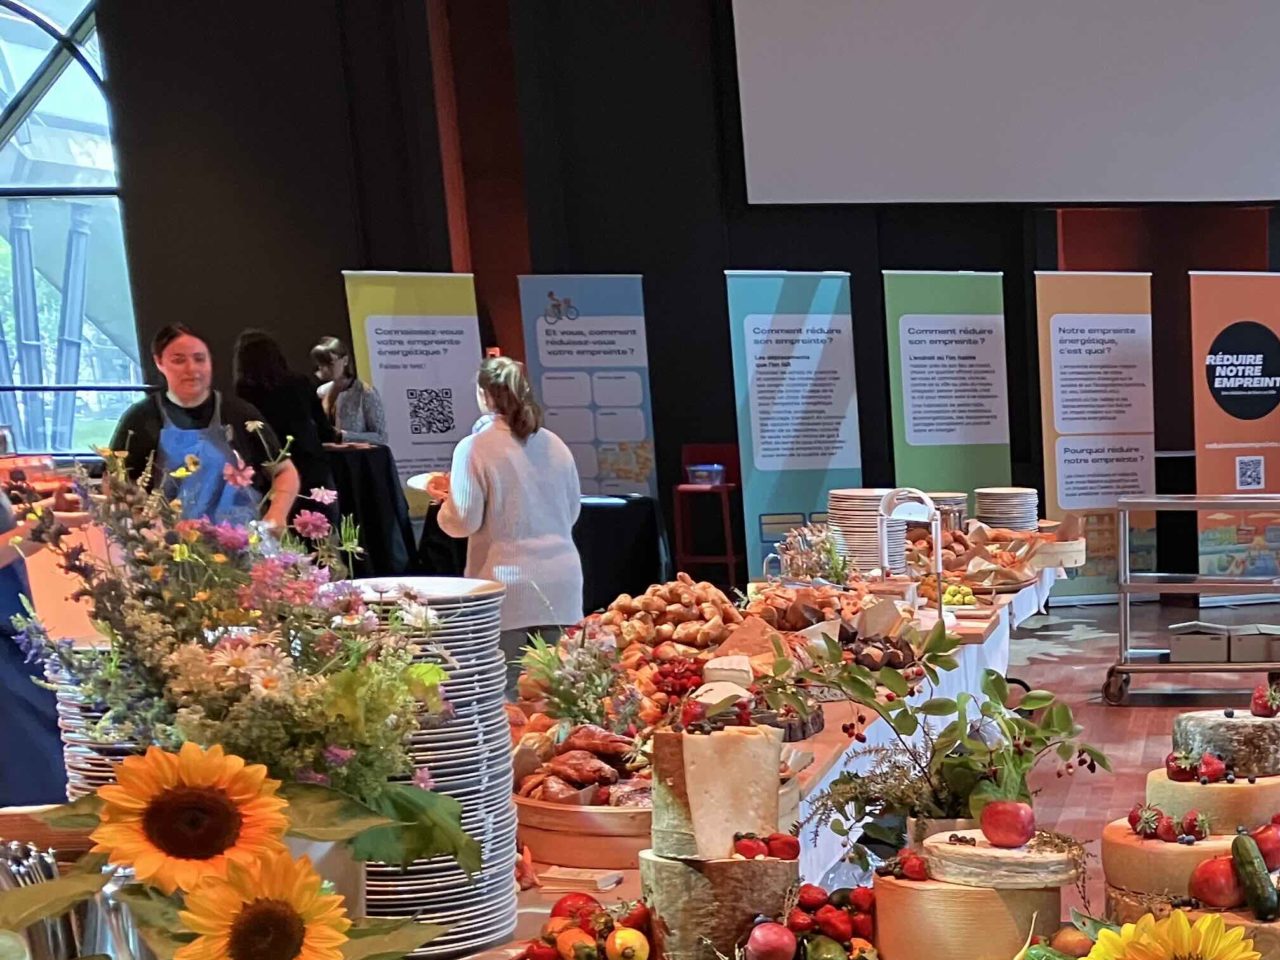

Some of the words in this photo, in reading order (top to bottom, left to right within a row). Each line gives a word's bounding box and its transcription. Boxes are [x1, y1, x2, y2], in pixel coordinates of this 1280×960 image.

[375, 328, 464, 336] Connaissez-vous
[806, 326, 842, 334] réduire
[908, 327, 956, 335] Comment
[959, 327, 993, 335] réduire
[1088, 327, 1136, 335] empreinte
[407, 339, 461, 347] empreinte
[1205, 352, 1264, 365] RÉDUIRE
[1215, 365, 1263, 377] NOTRE
[1064, 447, 1105, 455] Pourquoi
